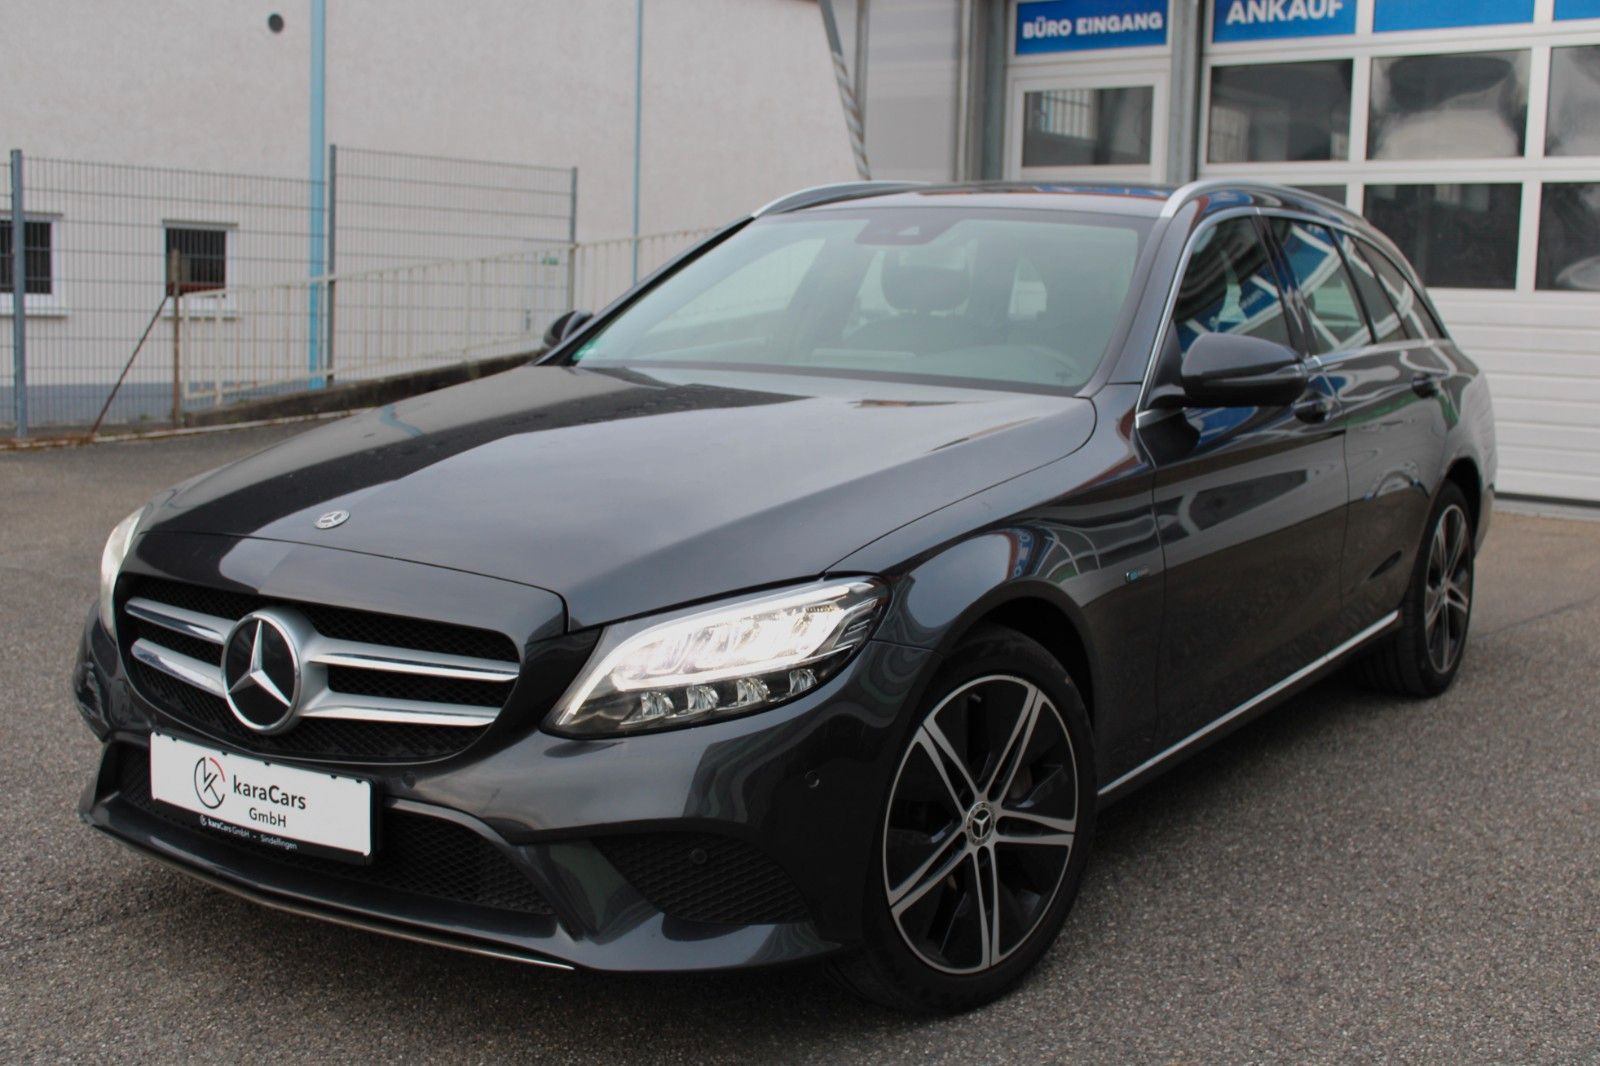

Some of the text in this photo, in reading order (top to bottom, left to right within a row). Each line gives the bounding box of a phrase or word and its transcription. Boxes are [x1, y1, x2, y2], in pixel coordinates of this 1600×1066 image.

[1022, 11, 1163, 39] BÜRO EINGANG
[1225, 0, 1343, 25] ANKAUF
[233, 774, 306, 810] karaCars
[249, 807, 286, 828] GmbH
